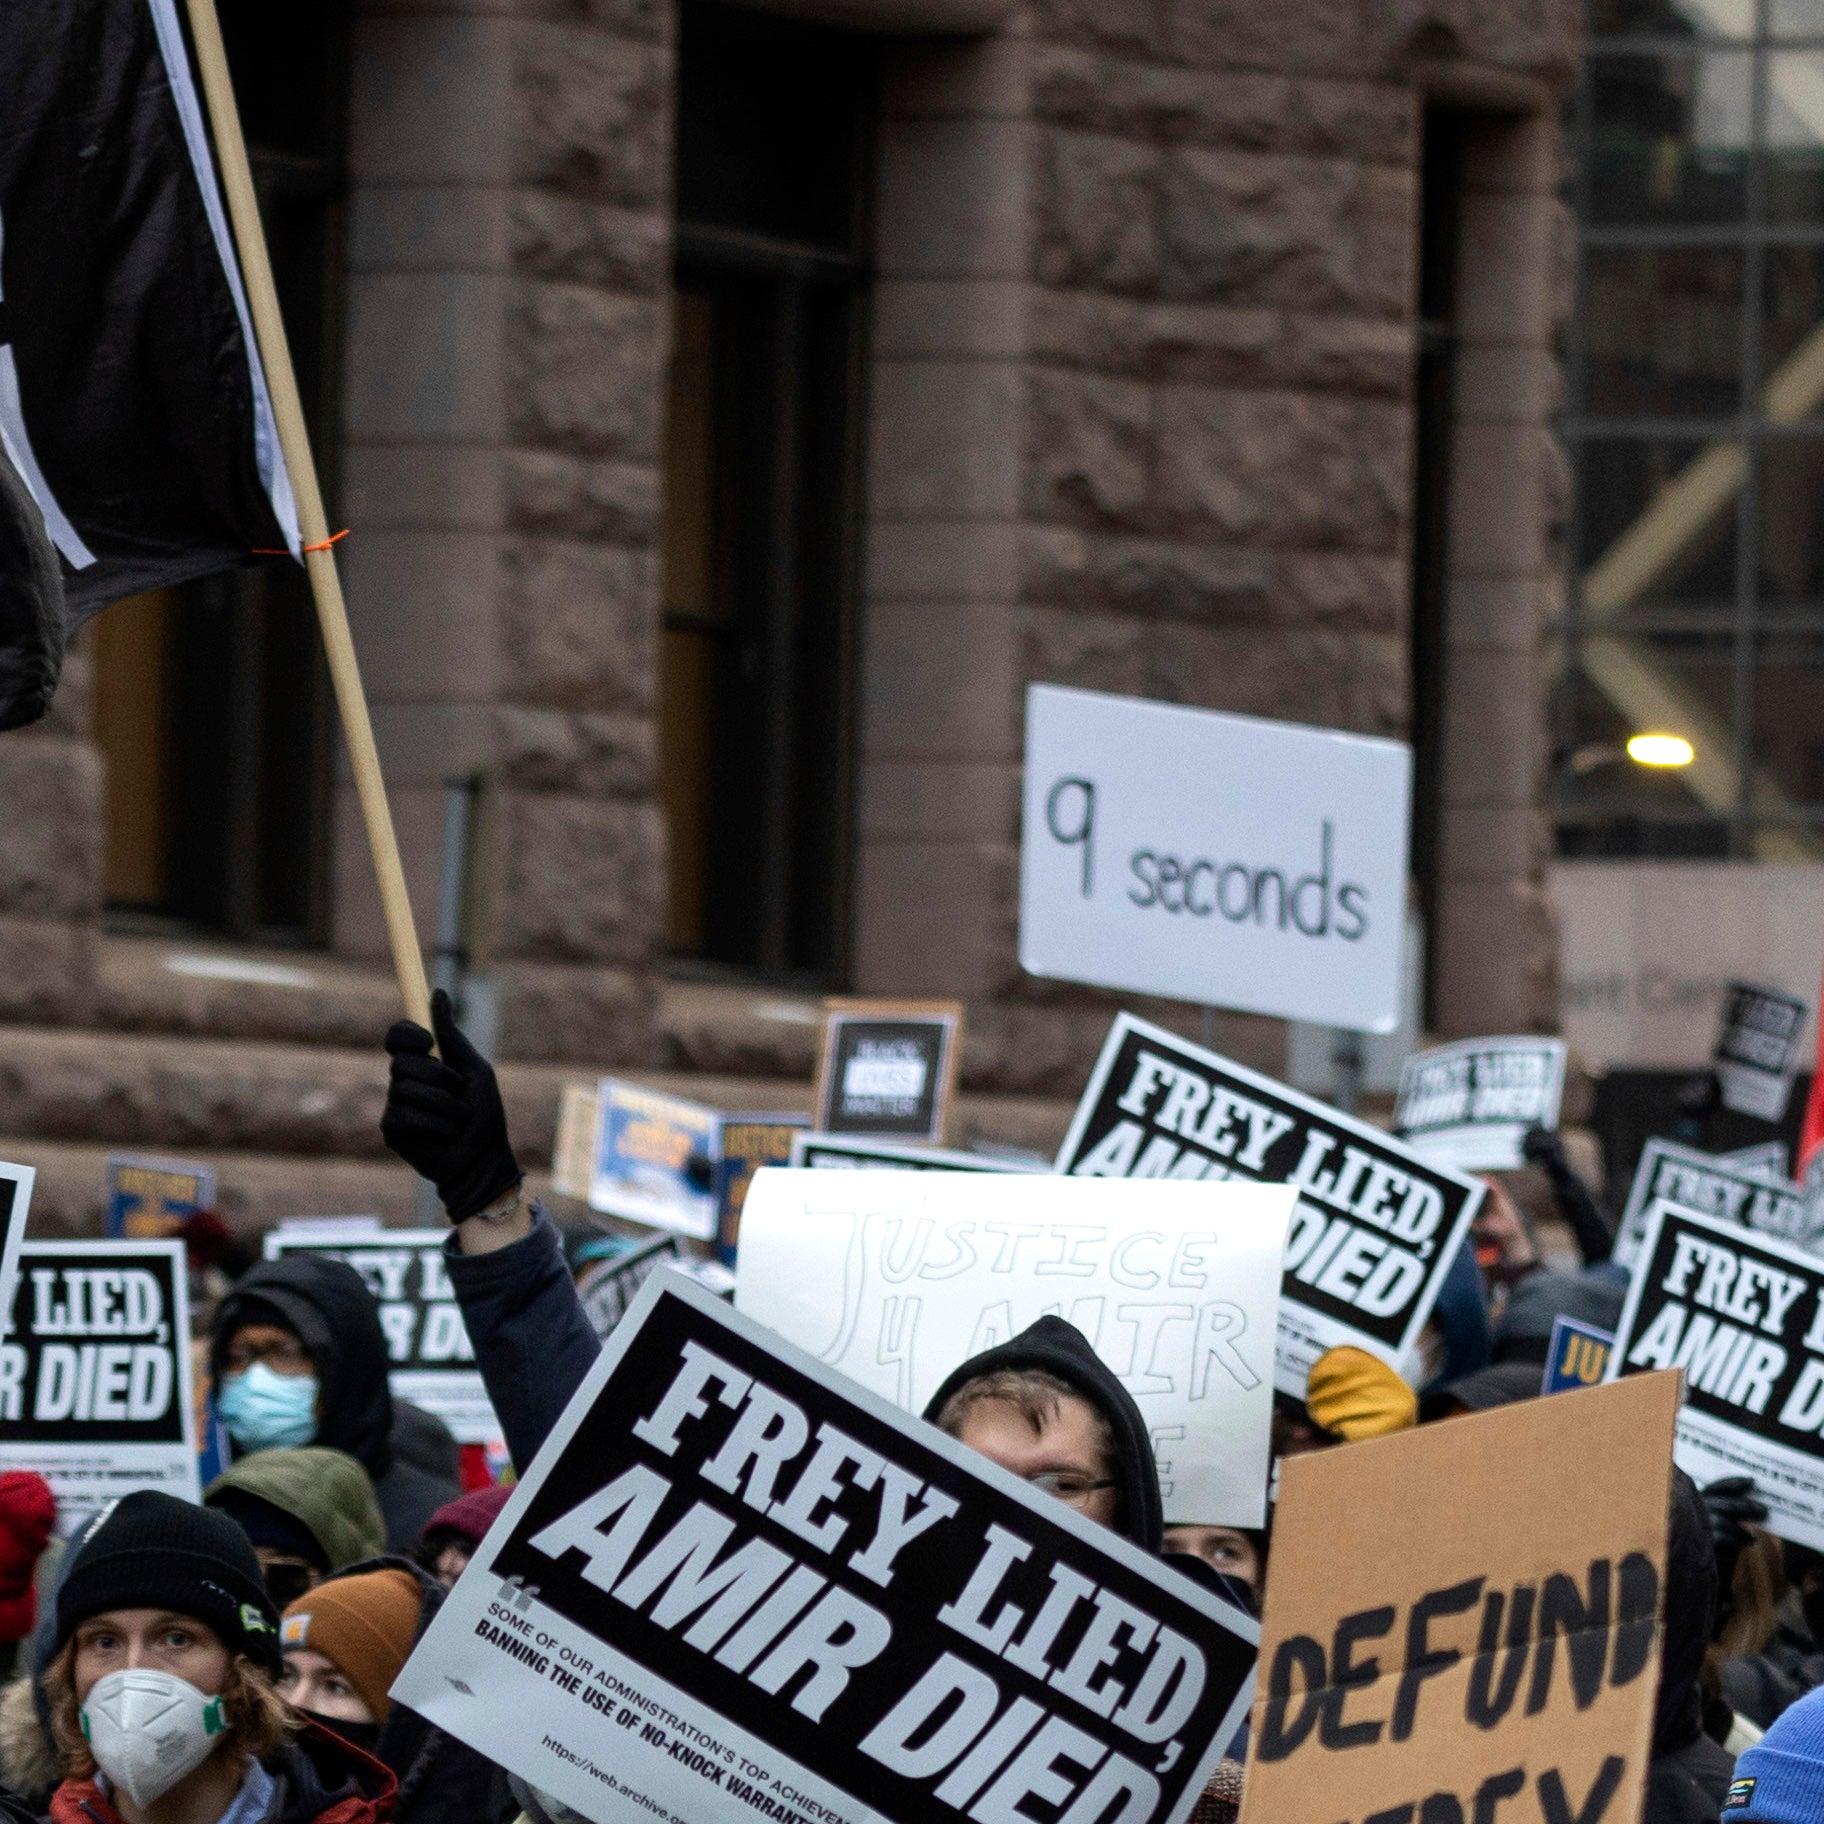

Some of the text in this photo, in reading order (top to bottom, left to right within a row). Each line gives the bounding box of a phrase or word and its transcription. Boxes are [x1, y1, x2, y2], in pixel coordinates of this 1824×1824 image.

[1046, 775, 1368, 940] 9 seconds
[1117, 1048, 1447, 1260] FREY LIED,
[31, 1268, 172, 1344] LIED,
[805, 1204, 1218, 1365] JUSTICE
[1629, 1303, 1789, 1415] AMIR
[1663, 1231, 1806, 1335] FREY
[34, 1343, 174, 1422] DIED
[528, 1463, 893, 1725] AMIR
[631, 1341, 1208, 1773] FREY LIED,
[474, 1618, 550, 1675] BANNING
[548, 1664, 584, 1696] THE
[581, 1685, 619, 1718] USE
[616, 1707, 642, 1732] OF
[639, 1721, 728, 1786] NO-KNOCK
[487, 1602, 534, 1637] SOME
[535, 1632, 560, 1651] OF
[559, 1647, 595, 1676] OUR
[594, 1670, 736, 1765] ADMINISTRATION'S
[738, 1758, 771, 1783] TOP
[1255, 1551, 1661, 1764] DEFUND
